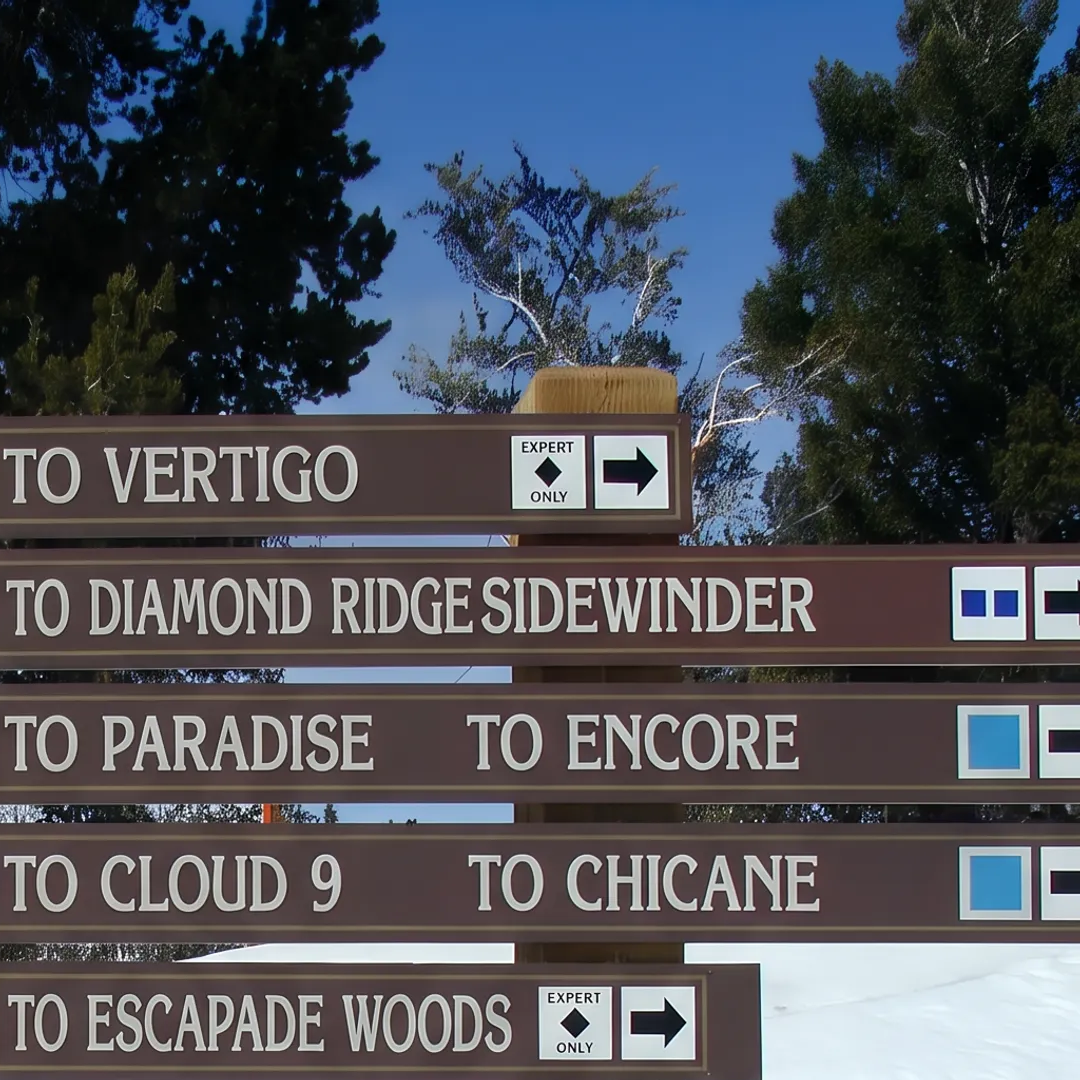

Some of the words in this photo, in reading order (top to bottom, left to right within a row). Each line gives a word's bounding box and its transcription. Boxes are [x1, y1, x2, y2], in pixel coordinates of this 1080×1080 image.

[3, 447, 80, 503] TO
[104, 445, 358, 503] VERTIGO
[522, 442, 574, 453] EXPERT
[531, 491, 567, 502] ONLY
[6, 579, 69, 636] TO
[89, 578, 311, 635] DIAMOND
[332, 577, 473, 634] RIDGE
[481, 577, 816, 633] SIDEWINDER
[5, 715, 77, 772] TO
[102, 714, 373, 771] PARADISE
[467, 714, 542, 770] TO
[567, 714, 799, 770] ENCORE
[4, 855, 77, 912] TO
[101, 855, 287, 912] CLOUD
[312, 854, 341, 911] 9
[468, 854, 543, 911] TO
[567, 855, 819, 911] CHICANE
[8, 994, 67, 1052] TO
[87, 994, 324, 1052] ESCAPADE
[342, 994, 512, 1053] WOODS
[548, 993, 600, 1003] EXPERT
[557, 1042, 593, 1053] ONLY
